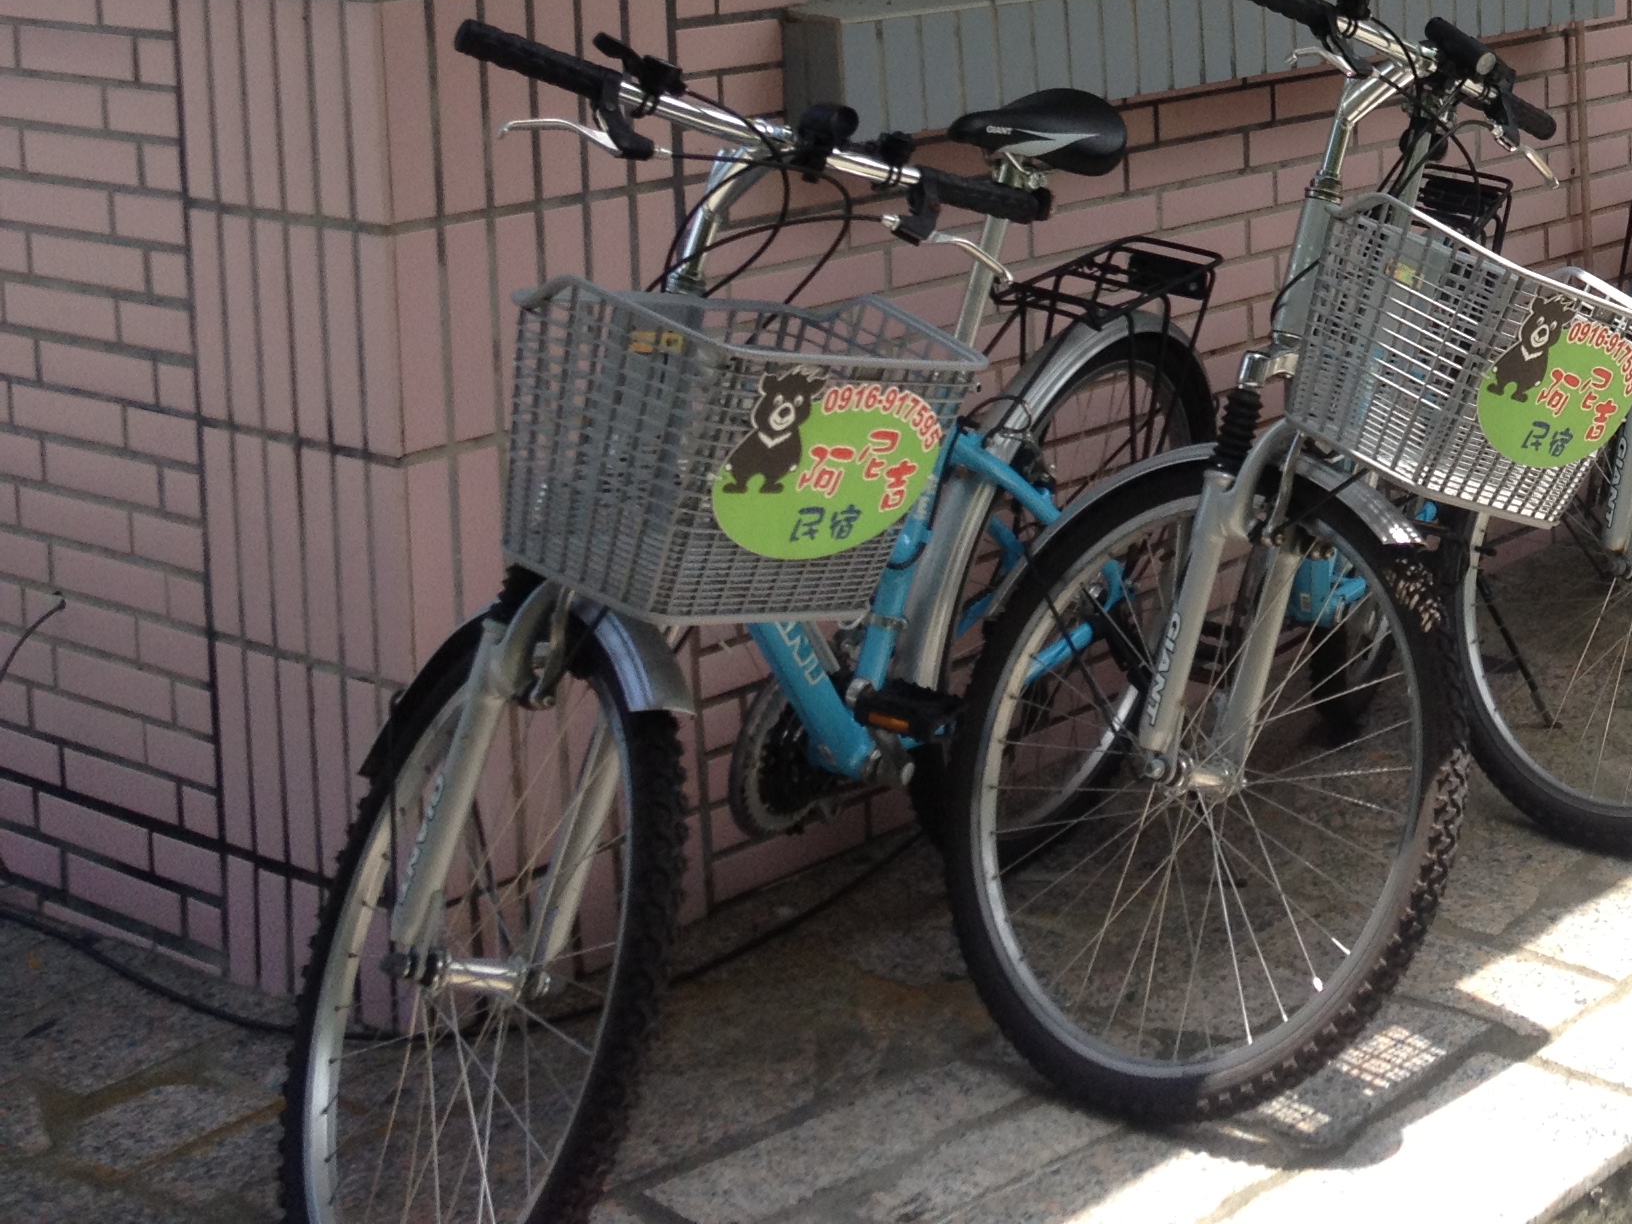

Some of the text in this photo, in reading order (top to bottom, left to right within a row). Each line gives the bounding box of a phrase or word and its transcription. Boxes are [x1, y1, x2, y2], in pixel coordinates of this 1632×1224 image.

[823, 384, 942, 452] 0916-917595
[1522, 421, 1573, 457] 民宿
[1606, 437, 1627, 529] GIANT
[789, 504, 863, 543] 民宿
[1147, 612, 1180, 727] GIANT
